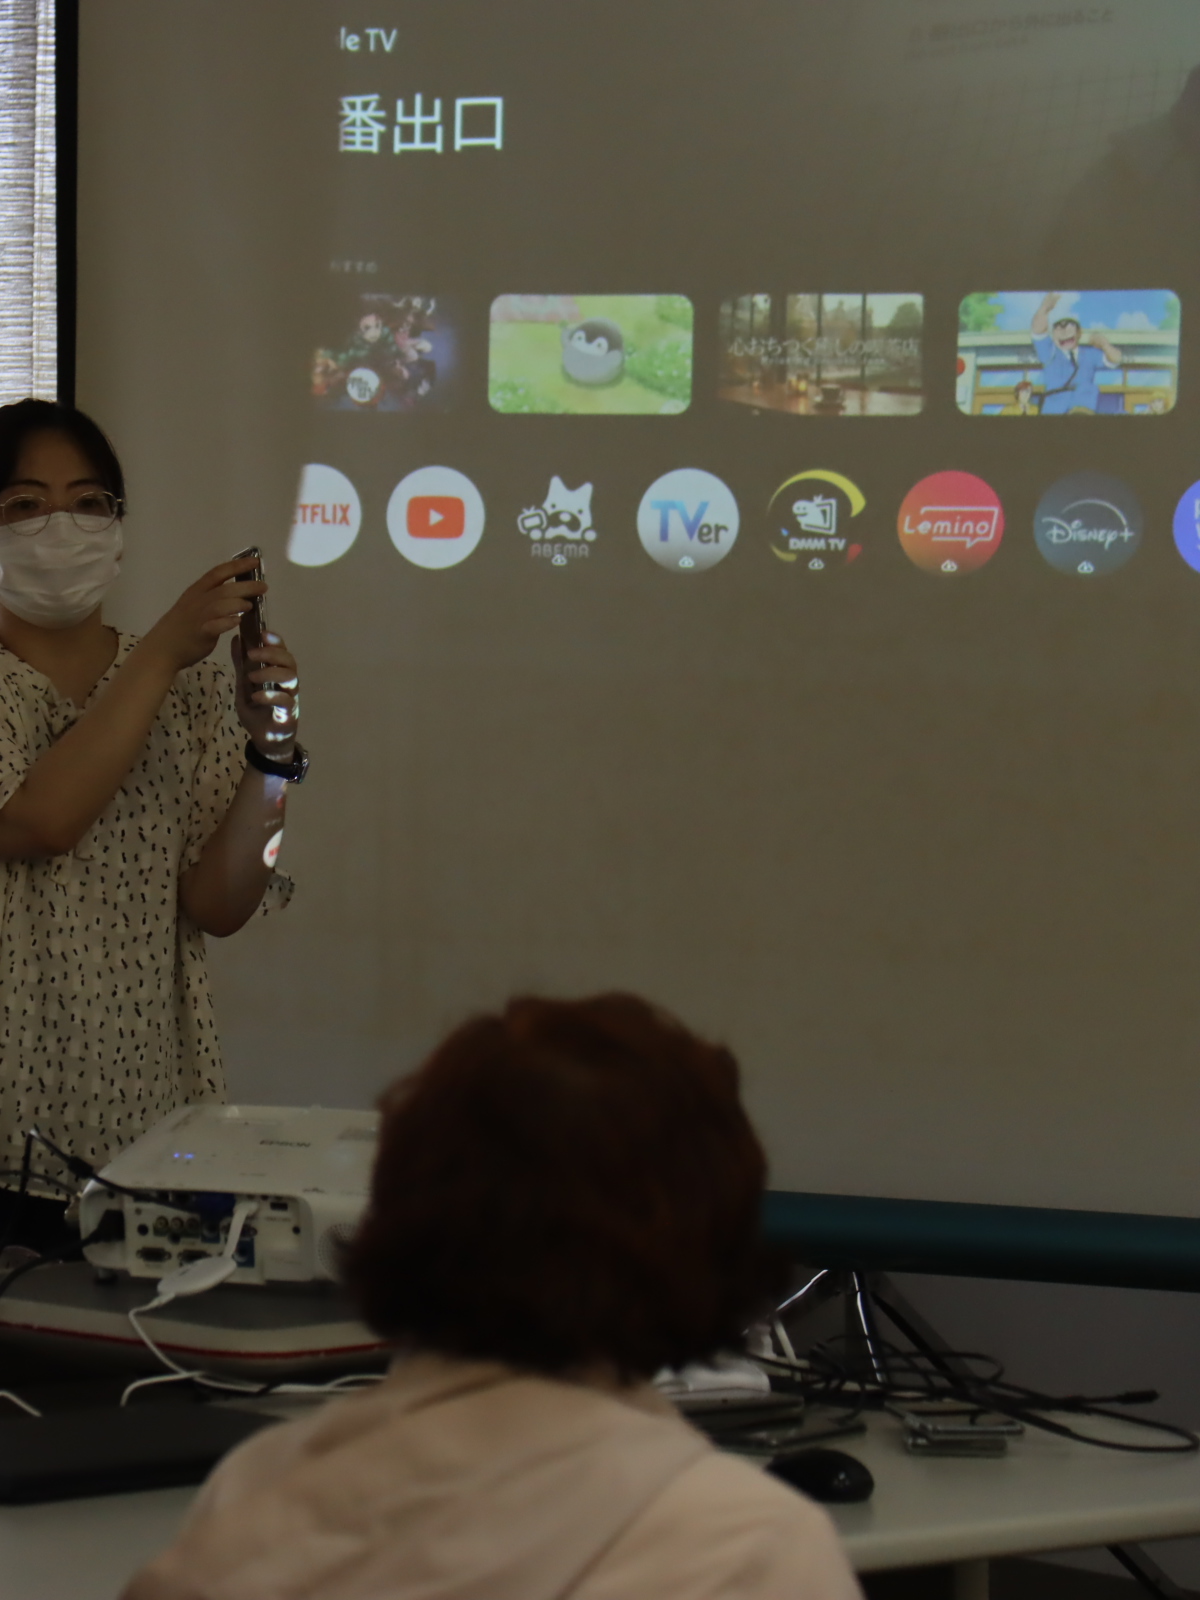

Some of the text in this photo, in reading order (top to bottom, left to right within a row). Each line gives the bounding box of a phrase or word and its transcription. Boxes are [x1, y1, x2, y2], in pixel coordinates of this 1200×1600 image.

[366, 28, 397, 52] TV
[338, 93, 503, 154] 番出口
[291, 503, 351, 526] TFLIX
[650, 500, 728, 544] TVer
[903, 515, 989, 534] Lemino
[531, 543, 589, 558] ABEMA
[789, 538, 846, 551] DMM TV
